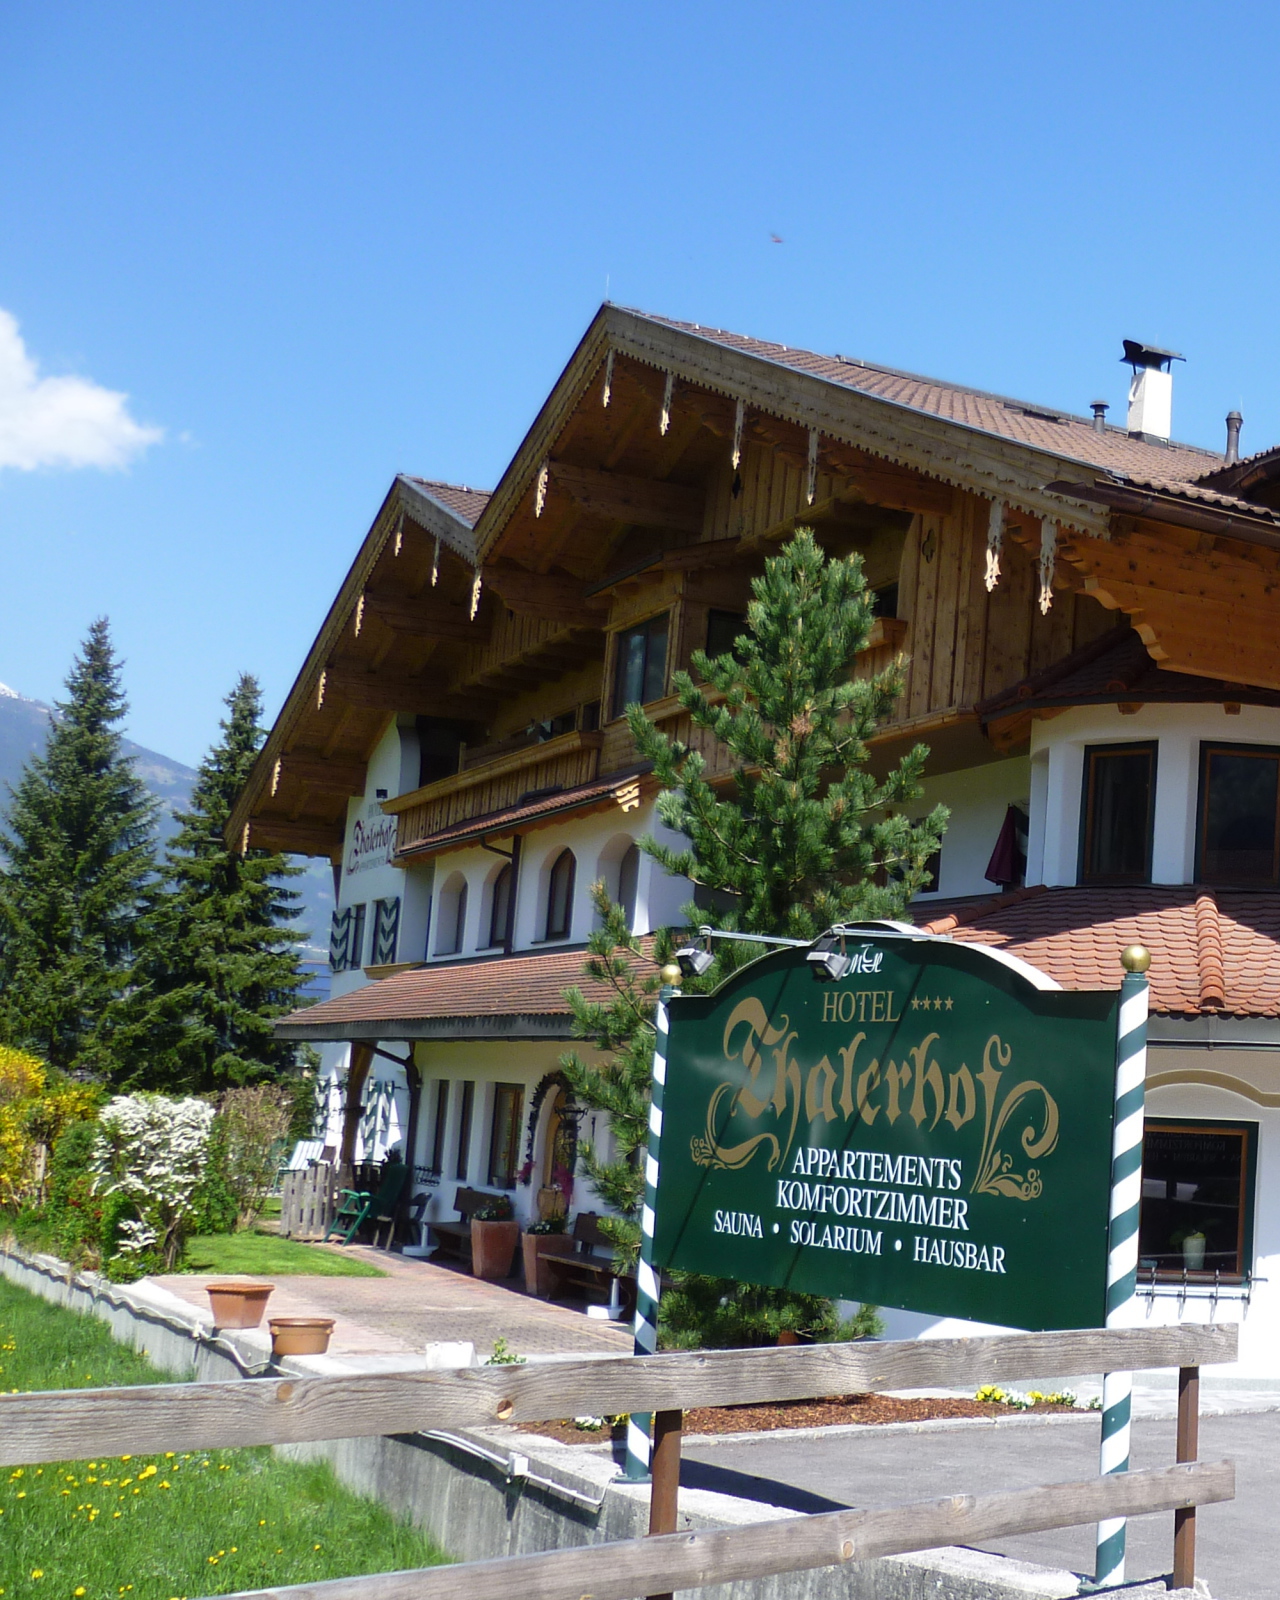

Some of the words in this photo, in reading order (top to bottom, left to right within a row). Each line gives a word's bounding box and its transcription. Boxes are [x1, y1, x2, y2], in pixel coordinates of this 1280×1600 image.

[821, 991, 900, 1023] HOTEL
[712, 997, 1026, 1182] Thalerhof
[791, 1147, 962, 1190] APPARTEMENTS
[776, 1180, 970, 1231] KOMFORTZIMMER
[714, 1210, 764, 1238] SAUNA
[790, 1220, 883, 1255] SOLARIUM
[913, 1236, 1007, 1273] HAUSBAR
